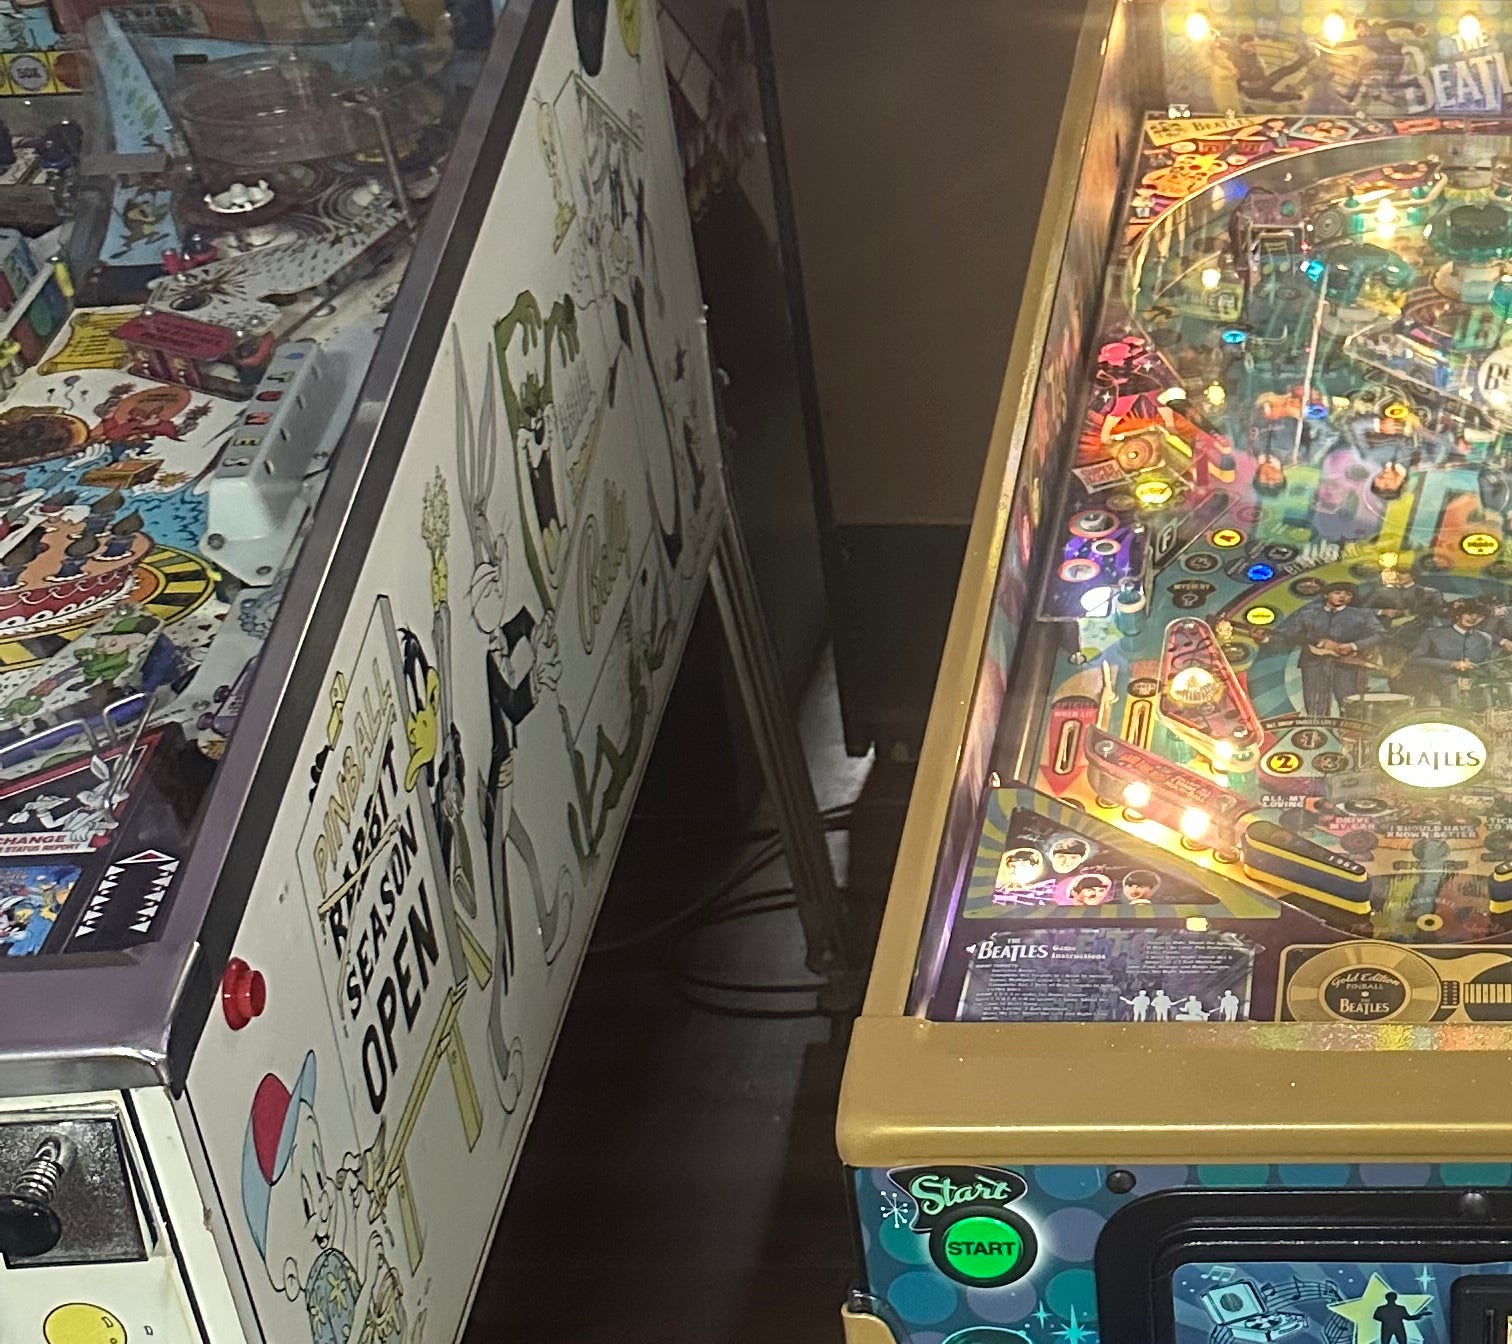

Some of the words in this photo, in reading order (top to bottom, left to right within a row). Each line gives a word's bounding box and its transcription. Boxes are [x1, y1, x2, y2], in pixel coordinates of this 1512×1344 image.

[1276, 756, 1293, 769] 2
[346, 805, 419, 1020] SEASON
[977, 942, 1049, 963] BEATLES
[1331, 973, 1359, 989] Gold
[360, 876, 440, 1116] OPEN
[1339, 998, 1390, 1016] BEATLES
[911, 1174, 1013, 1216] Start
[947, 1241, 1017, 1256] START
